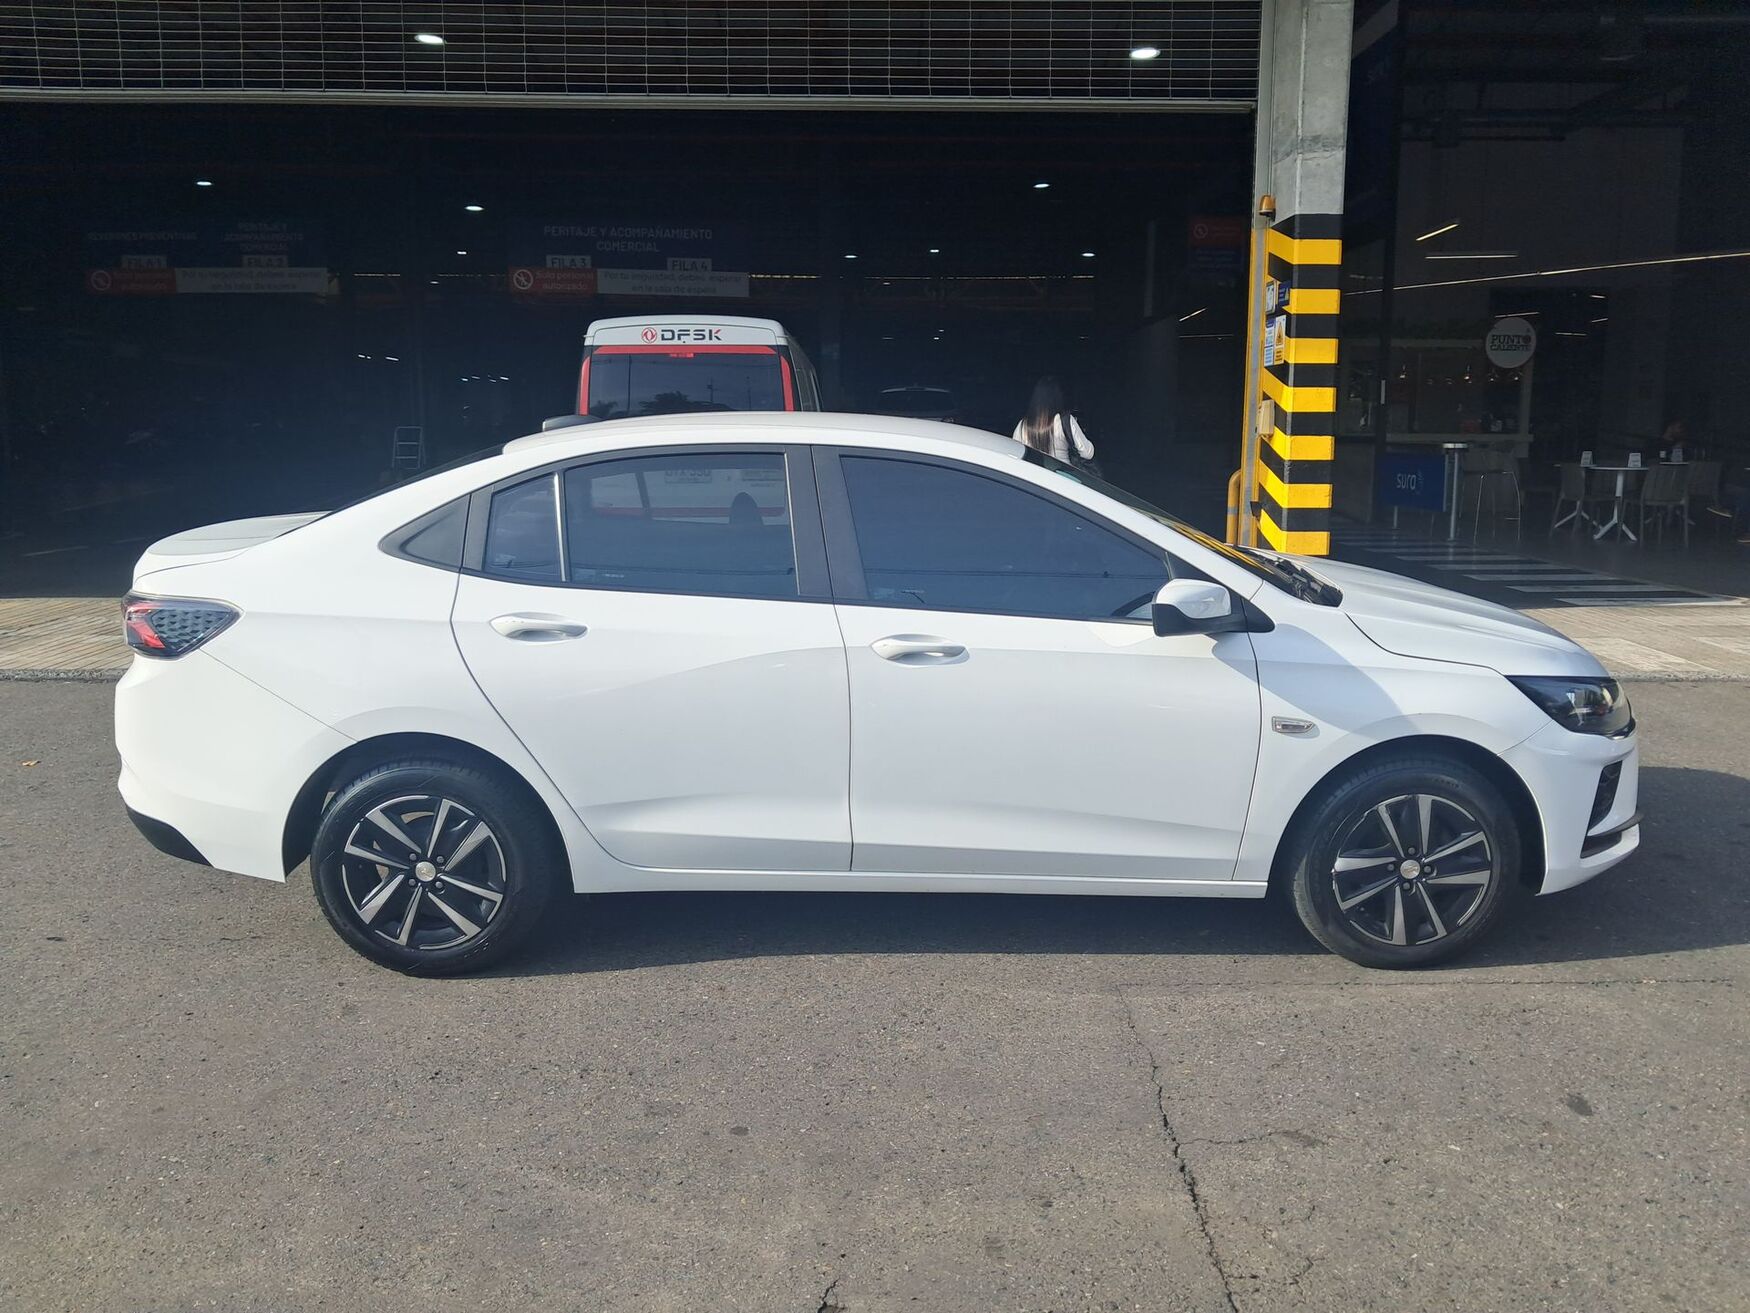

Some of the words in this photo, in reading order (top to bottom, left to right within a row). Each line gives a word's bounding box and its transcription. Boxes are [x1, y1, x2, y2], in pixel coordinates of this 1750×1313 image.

[544, 225, 599, 238] PERITAJE
[600, 226, 606, 238] Y
[610, 225, 713, 240] ACOMPAÑAMIENTO
[596, 240, 660, 253] COMERCIAL
[551, 257, 576, 269] FILA
[580, 257, 587, 269] 3
[672, 259, 696, 271] FILA
[700, 260, 708, 272] 4
[660, 328, 722, 341] DFSK
[1491, 334, 1532, 345] PUNTO
[1396, 473, 1417, 490] sura
